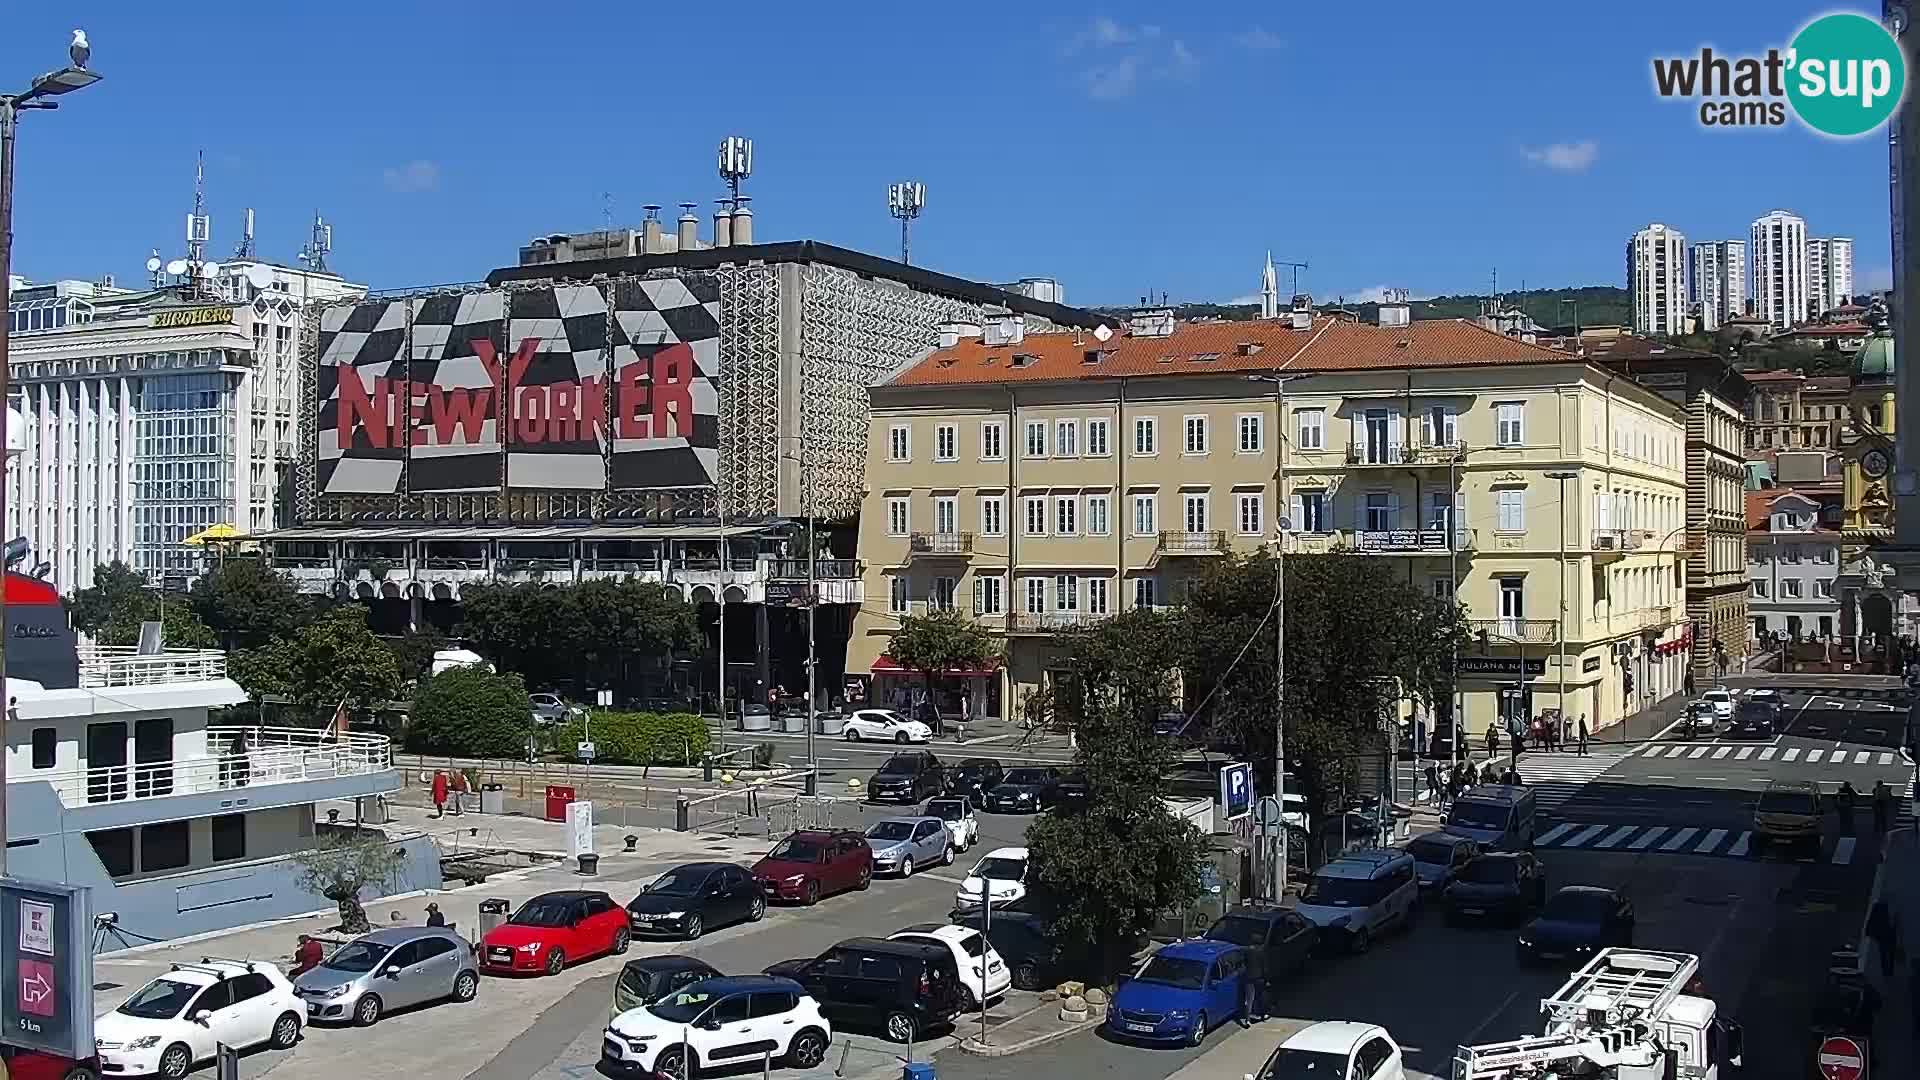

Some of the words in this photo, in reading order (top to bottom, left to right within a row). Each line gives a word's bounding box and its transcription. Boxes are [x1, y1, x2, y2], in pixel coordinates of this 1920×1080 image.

[1459, 662, 1504, 670] JULIANA
[20, 1018, 26, 1030] 5
[27, 1019, 41, 1033] km
